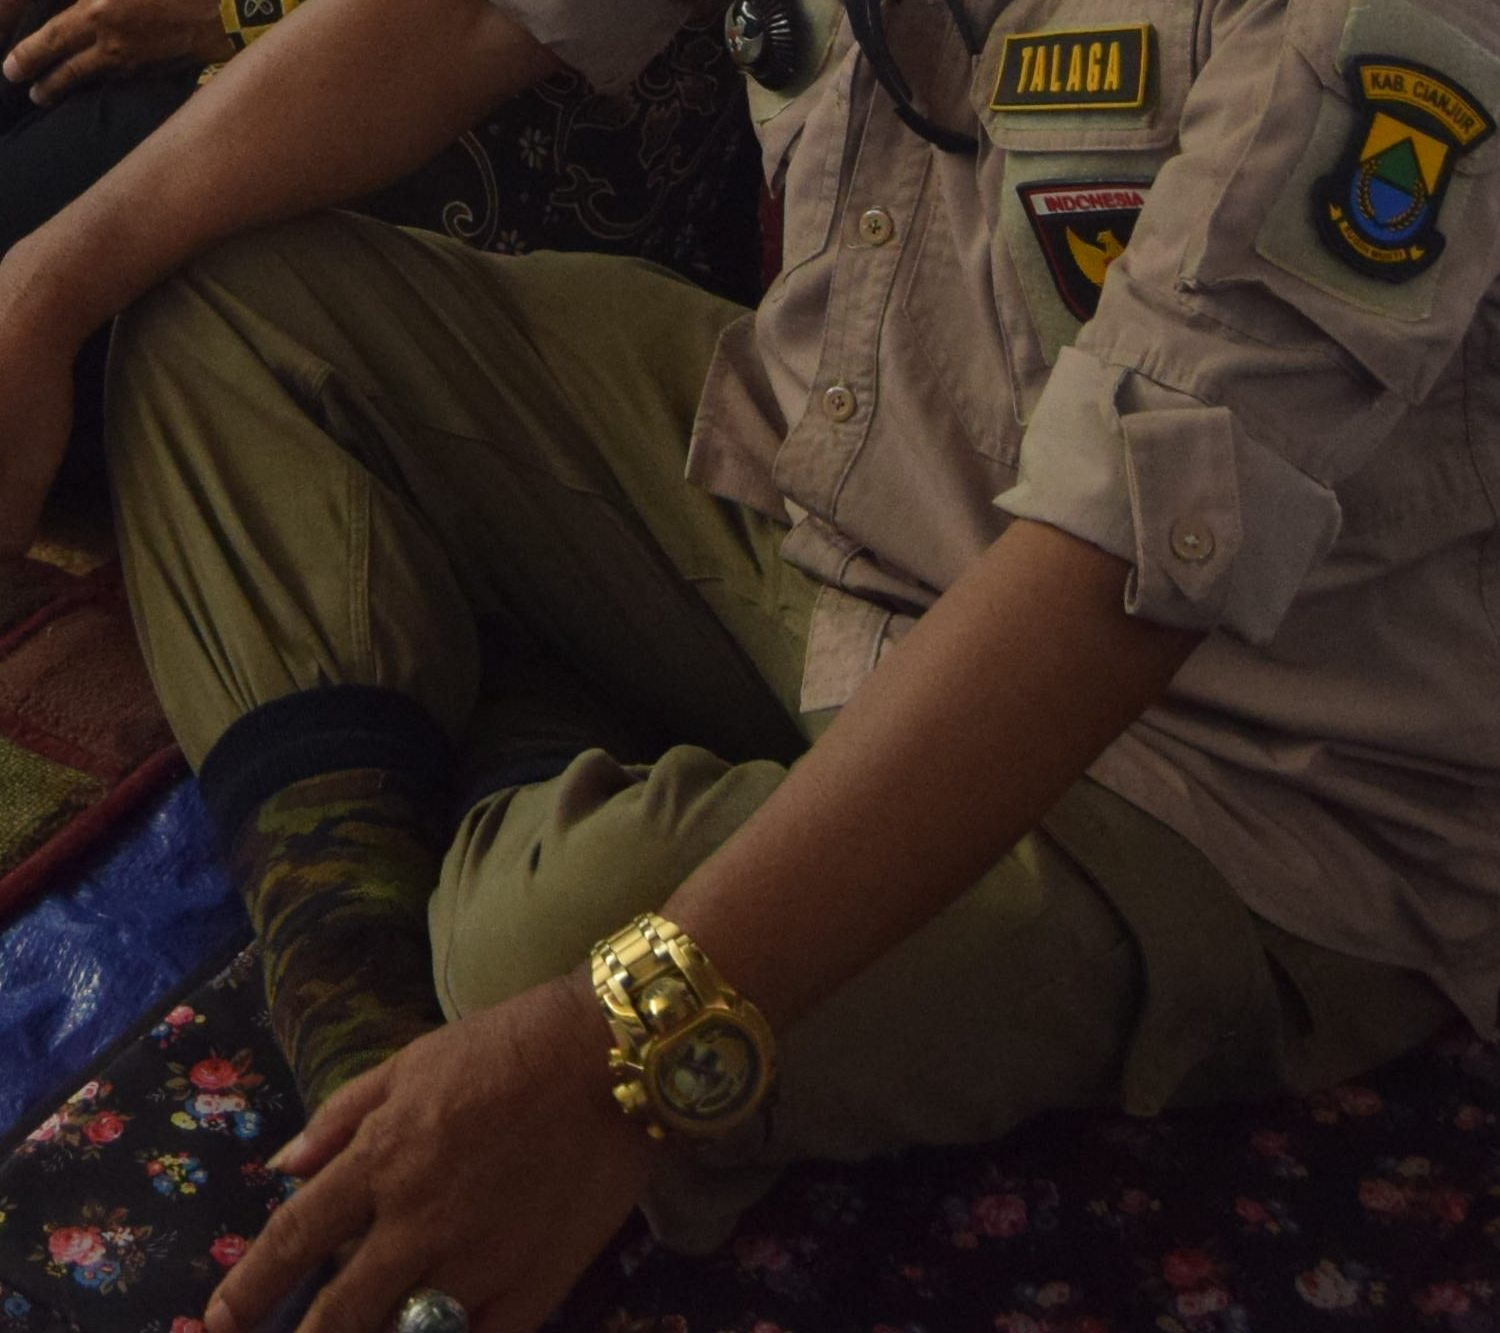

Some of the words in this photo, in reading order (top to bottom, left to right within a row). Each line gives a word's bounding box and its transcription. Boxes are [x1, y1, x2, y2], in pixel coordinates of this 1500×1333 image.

[1015, 40, 1122, 95] TALAGA
[1370, 71, 1408, 94] KAB.
[1412, 80, 1477, 133] CIANJUR
[1044, 190, 1146, 213] INDONESIA
